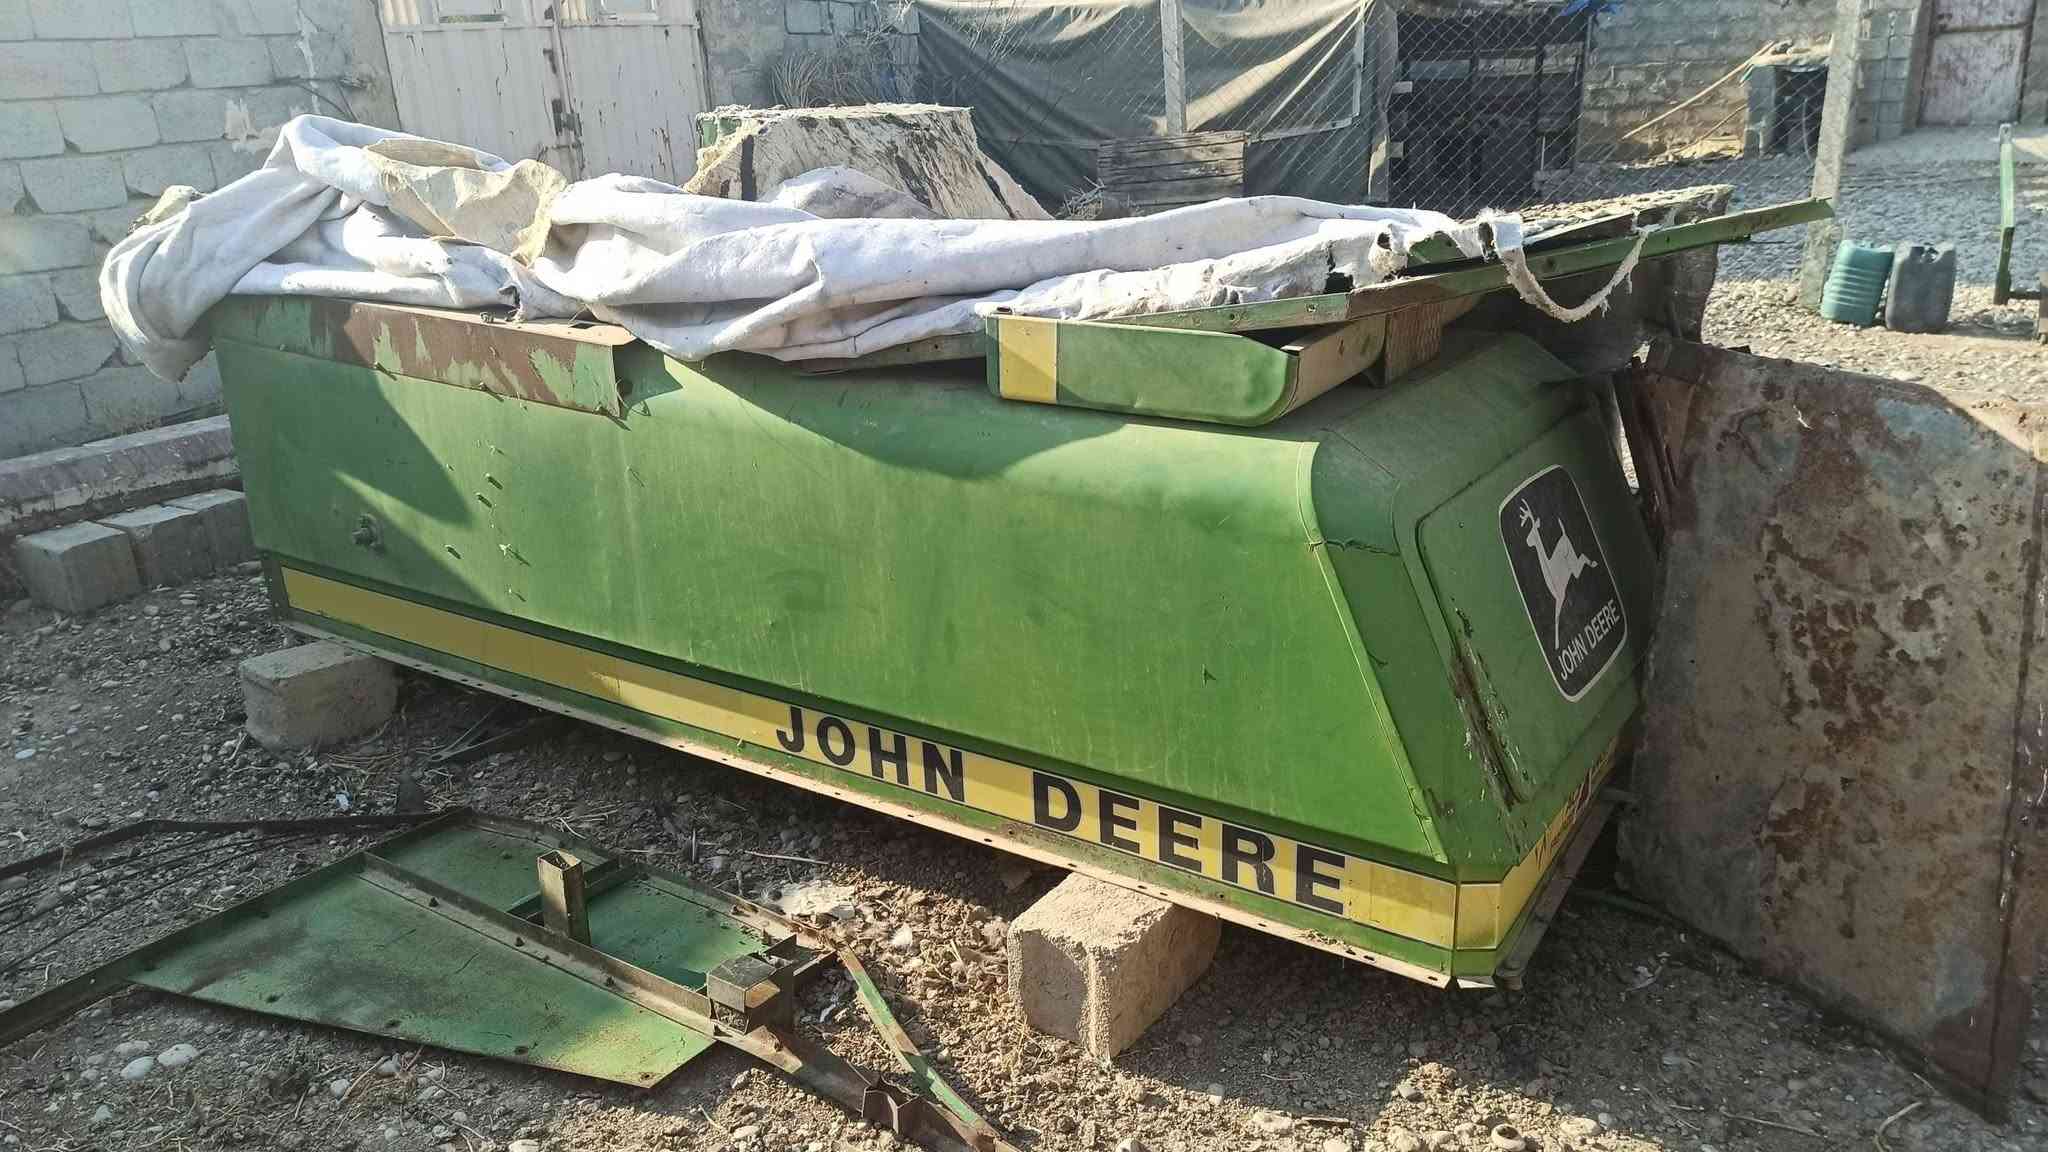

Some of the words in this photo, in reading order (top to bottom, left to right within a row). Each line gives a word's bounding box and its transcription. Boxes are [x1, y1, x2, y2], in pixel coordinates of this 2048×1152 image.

[1558, 633, 1588, 681] JOHN
[1584, 599, 1620, 649] DEERE
[776, 705, 965, 802] JOHN
[1033, 771, 1346, 915] DEERE
